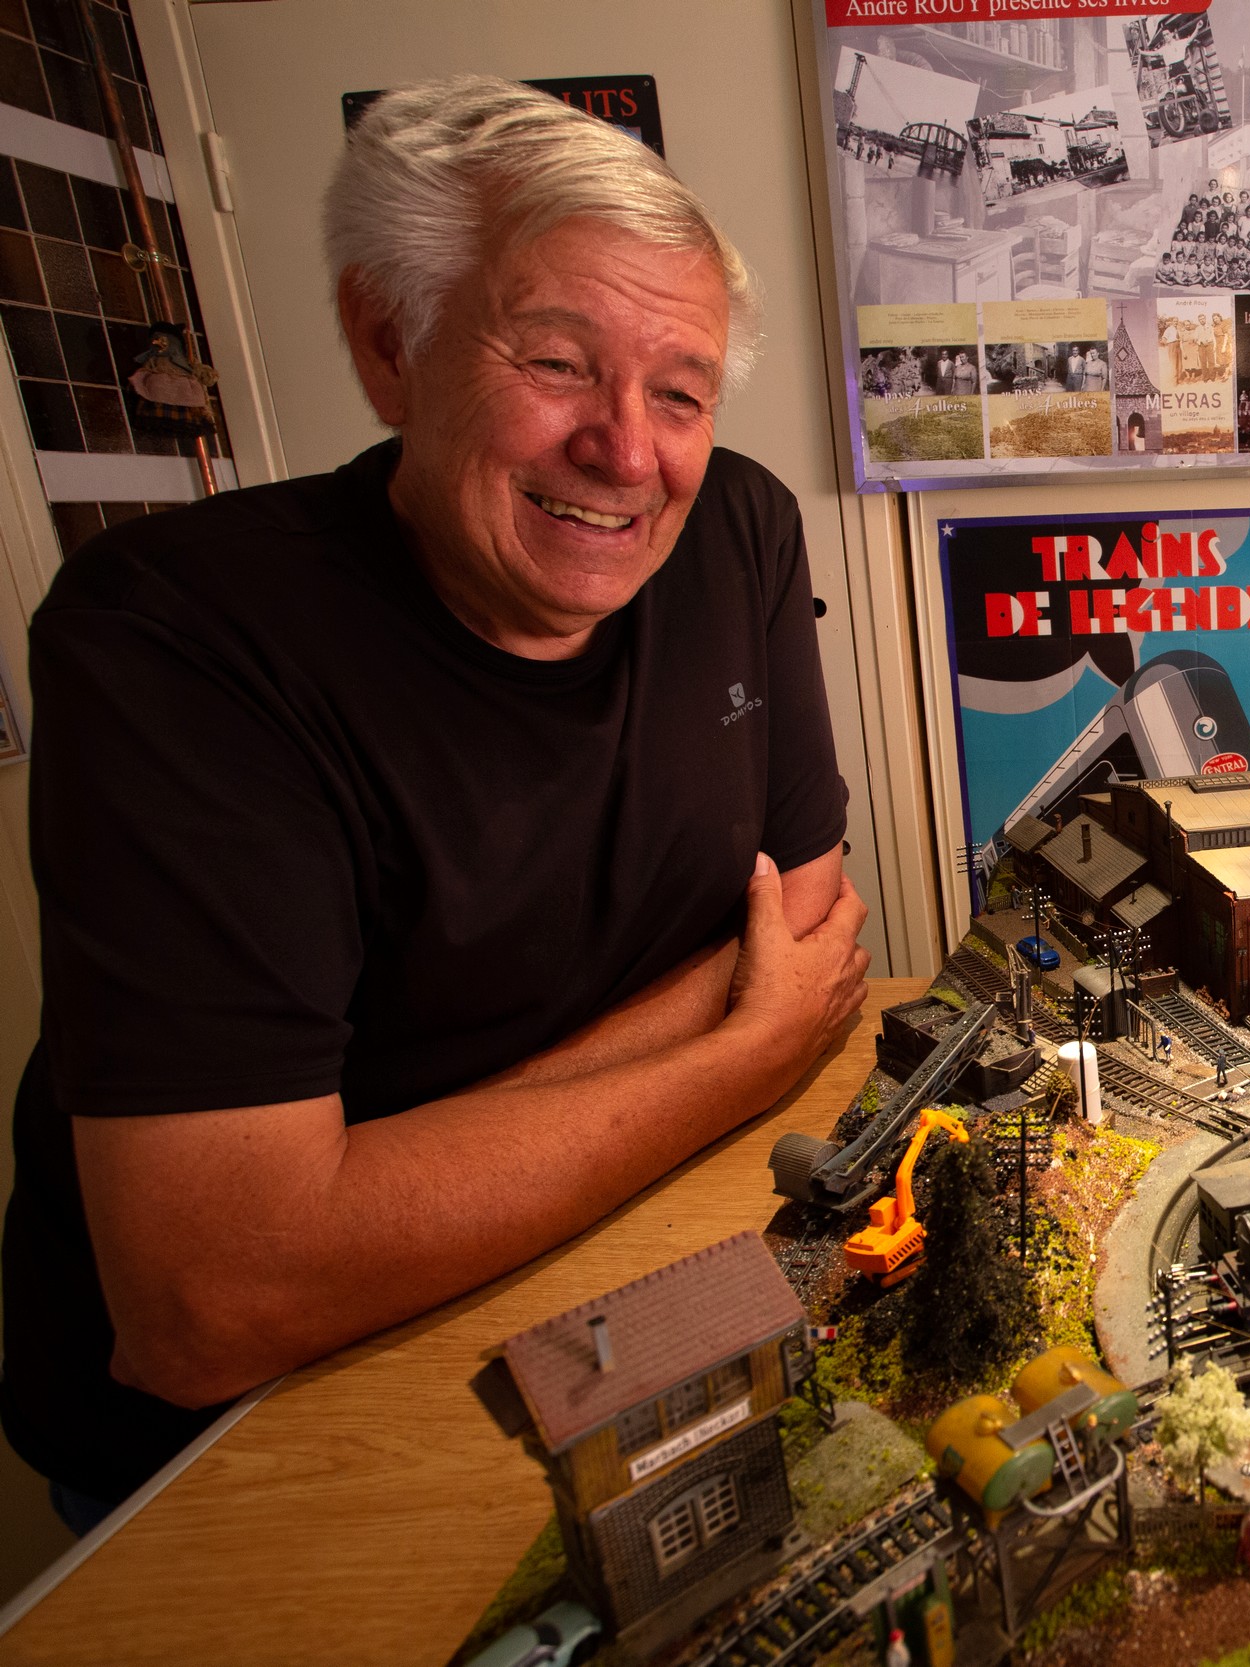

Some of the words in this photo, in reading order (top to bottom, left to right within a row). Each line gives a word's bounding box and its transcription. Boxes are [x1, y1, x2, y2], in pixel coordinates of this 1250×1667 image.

[846, 0, 907, 16] André
[914, 0, 980, 15] ROUY
[1078, 0, 1108, 8] ses
[884, 391, 912, 404] pays
[1014, 388, 1042, 401] pays
[1145, 392, 1222, 410] MEYRAS
[907, 397, 923, 419] 4
[925, 399, 967, 412] vallées
[1037, 394, 1053, 416] 4
[1056, 396, 1098, 409] vallées
[1179, 410, 1200, 419] village
[984, 590, 1052, 637] DE
[720, 697, 763, 727] DOMYOS
[1203, 760, 1247, 775] CENTRAL
